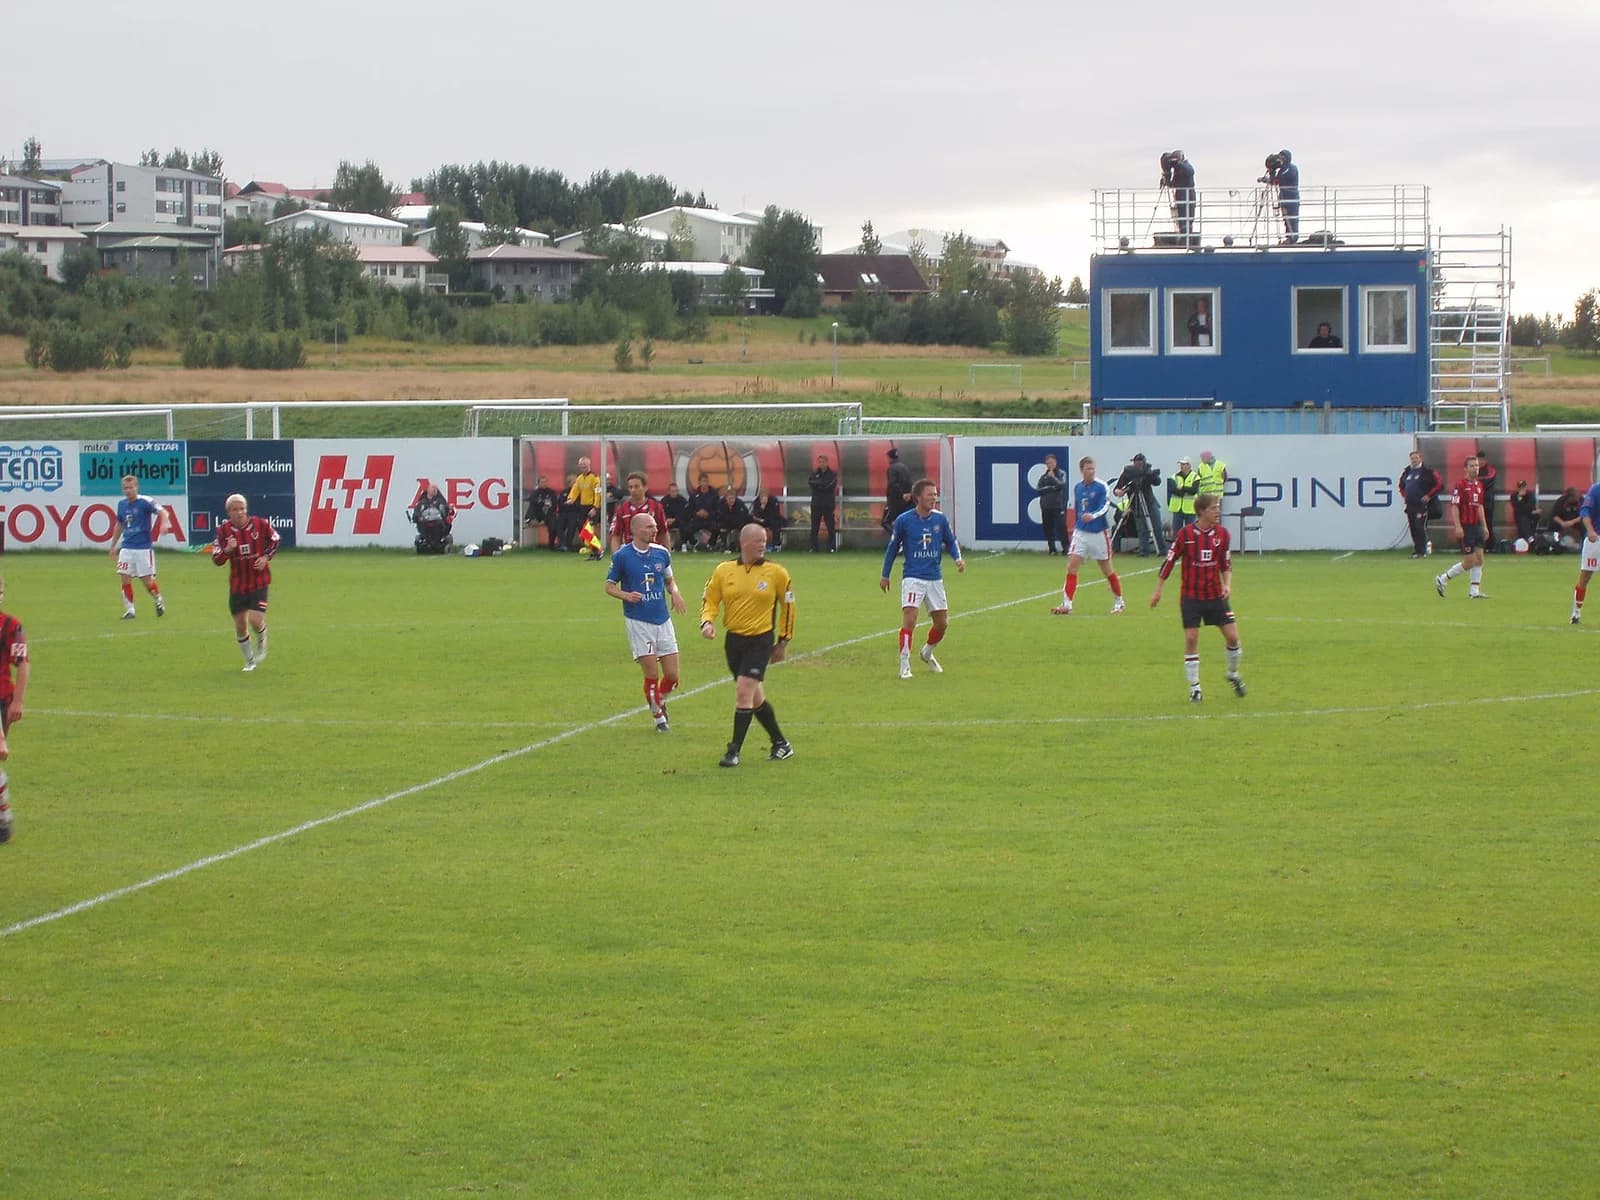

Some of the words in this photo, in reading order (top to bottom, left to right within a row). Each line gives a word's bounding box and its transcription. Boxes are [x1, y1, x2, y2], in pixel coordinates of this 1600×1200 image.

[84, 443, 110, 452] mitre
[87, 457, 114, 480] Jói
[119, 457, 179, 485] útherji
[214, 460, 292, 473] Landsbankinn
[0, 503, 186, 543] OYOA
[1588, 559, 1597, 567] 10
[909, 592, 916, 602] 11
[646, 641, 653, 653] 7
